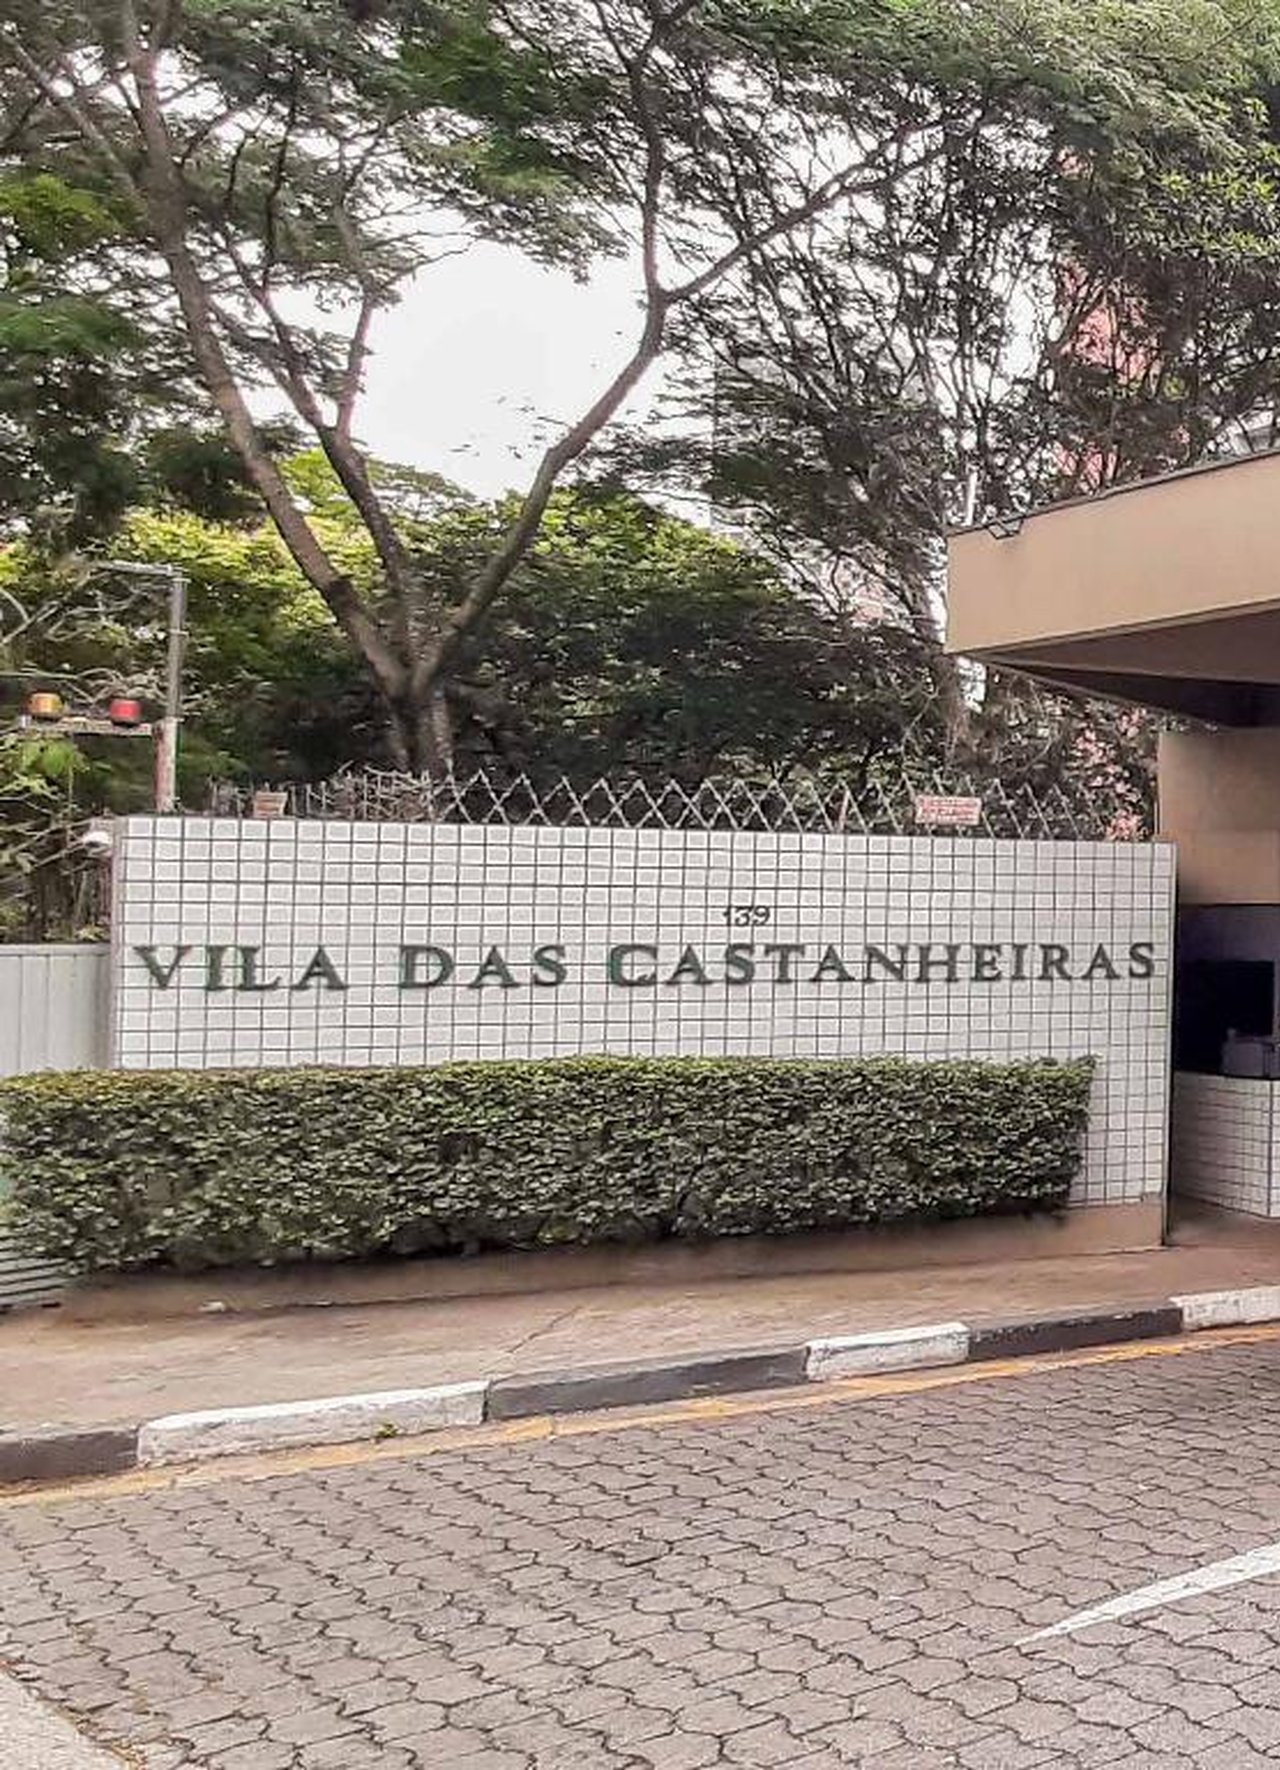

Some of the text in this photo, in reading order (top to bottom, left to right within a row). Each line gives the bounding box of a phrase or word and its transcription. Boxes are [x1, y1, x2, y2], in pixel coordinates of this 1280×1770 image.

[723, 905, 770, 927] 139
[132, 942, 1156, 991] VILA DAS CASTANHEIRAS
